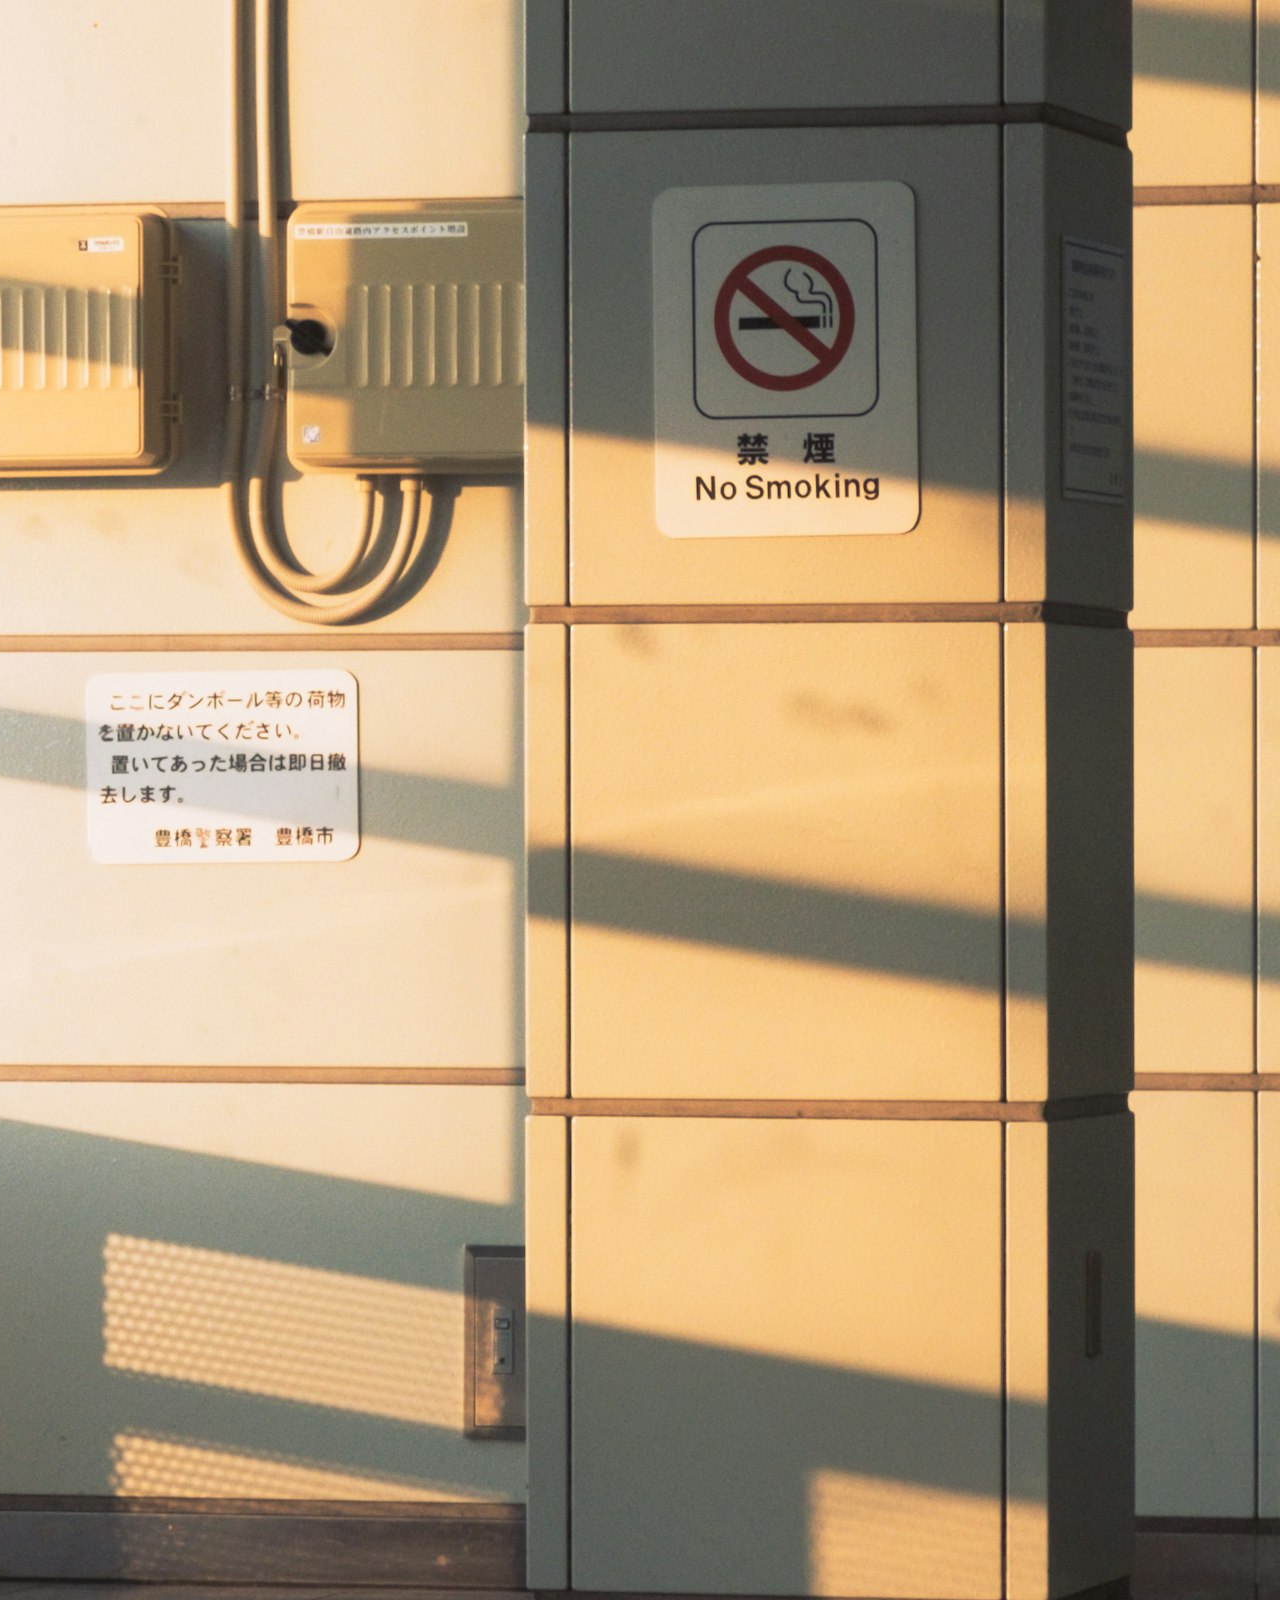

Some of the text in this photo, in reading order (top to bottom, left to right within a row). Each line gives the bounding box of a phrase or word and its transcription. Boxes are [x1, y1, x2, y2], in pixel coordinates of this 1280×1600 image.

[737, 432, 836, 466] 禁煙
[695, 472, 880, 501] No Smoking
[109, 689, 347, 711] ここにダンボール等の荷物
[111, 752, 347, 775] 置いてあった場合は即日撤
[100, 785, 185, 805] 去します。
[154, 826, 335, 849] 豊橋警察署 豊橋市
